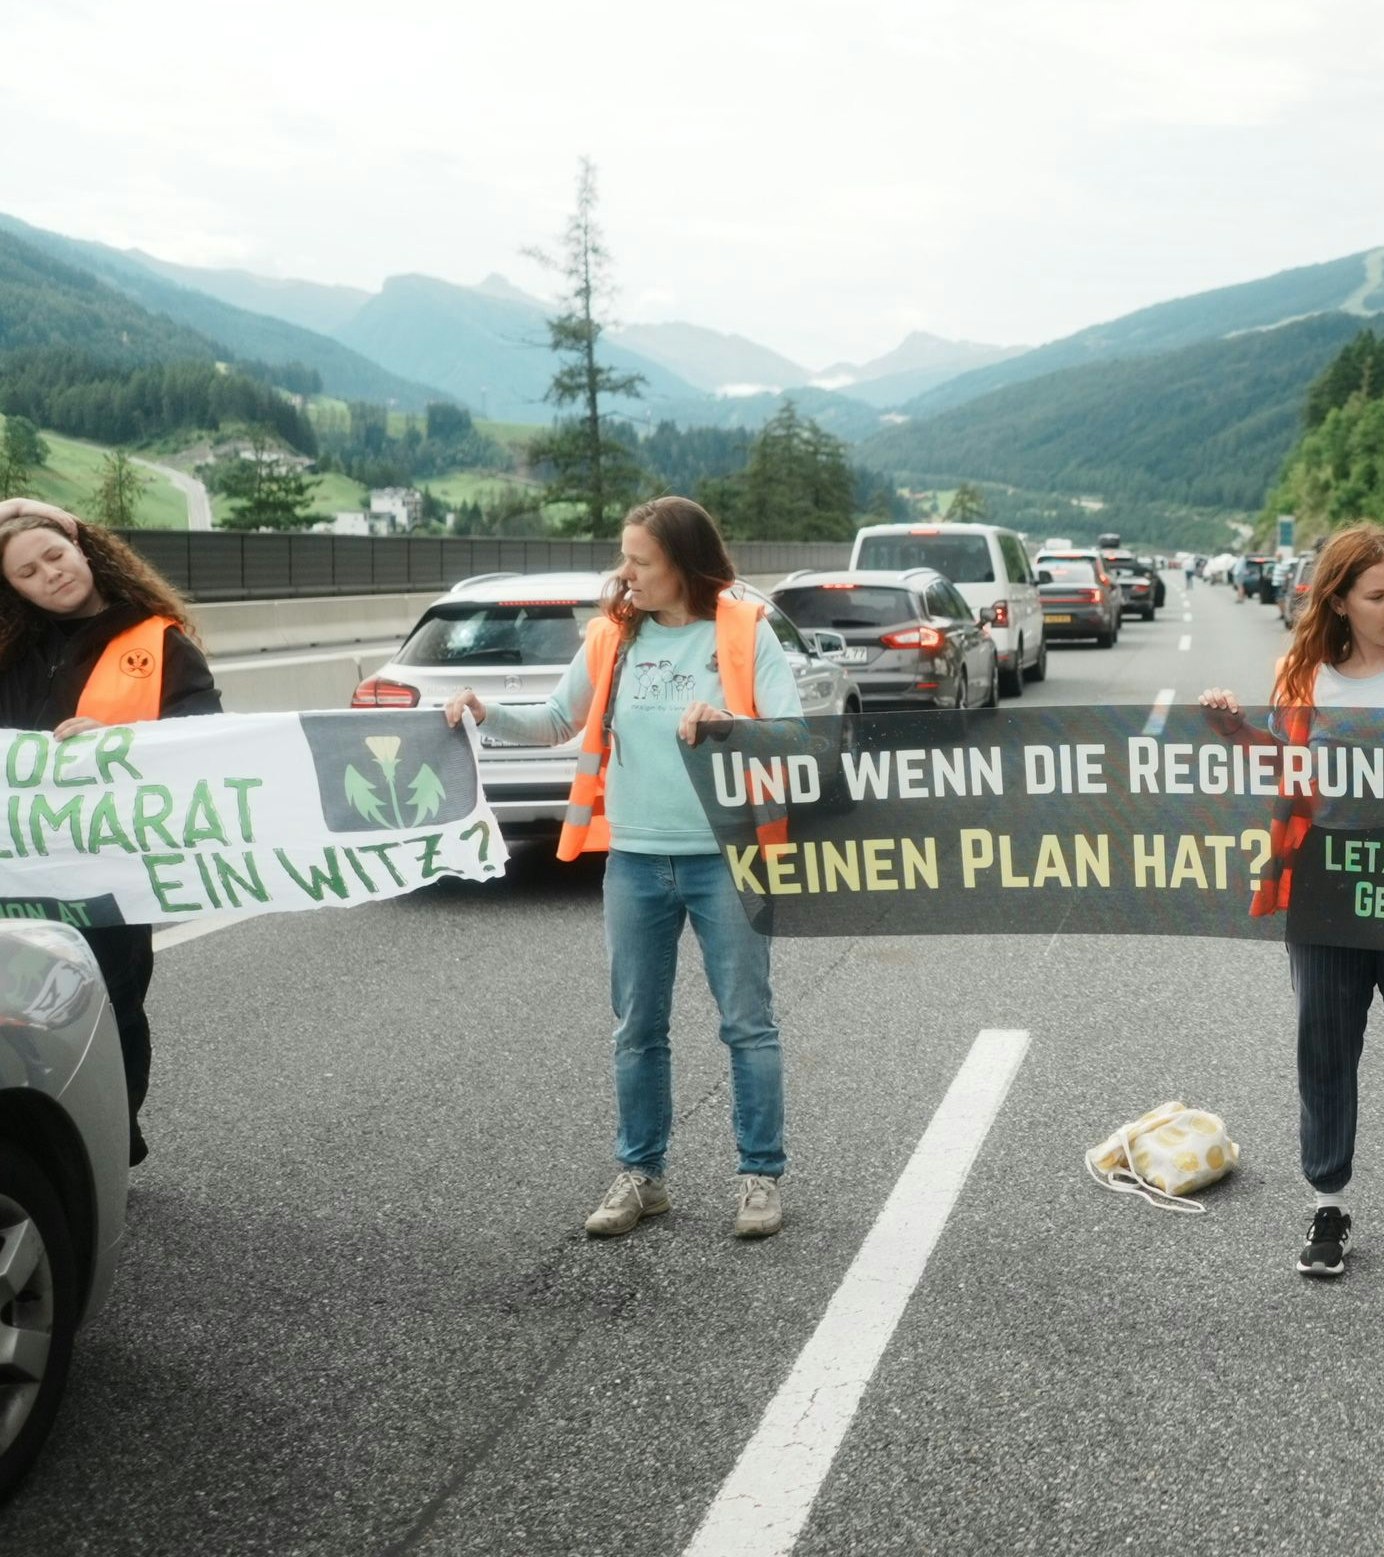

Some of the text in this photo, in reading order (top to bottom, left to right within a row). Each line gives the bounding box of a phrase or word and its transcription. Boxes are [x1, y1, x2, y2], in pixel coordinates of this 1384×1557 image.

[6, 727, 143, 788] DER
[711, 750, 821, 808] UND
[842, 746, 1004, 800] WENN
[1024, 744, 1108, 795] DIE
[0, 777, 262, 858] IMARAT
[142, 820, 496, 912] EIN WITZ?
[726, 828, 1273, 895] KEINEN PLAN HAT?
[57, 901, 93, 927] AT
